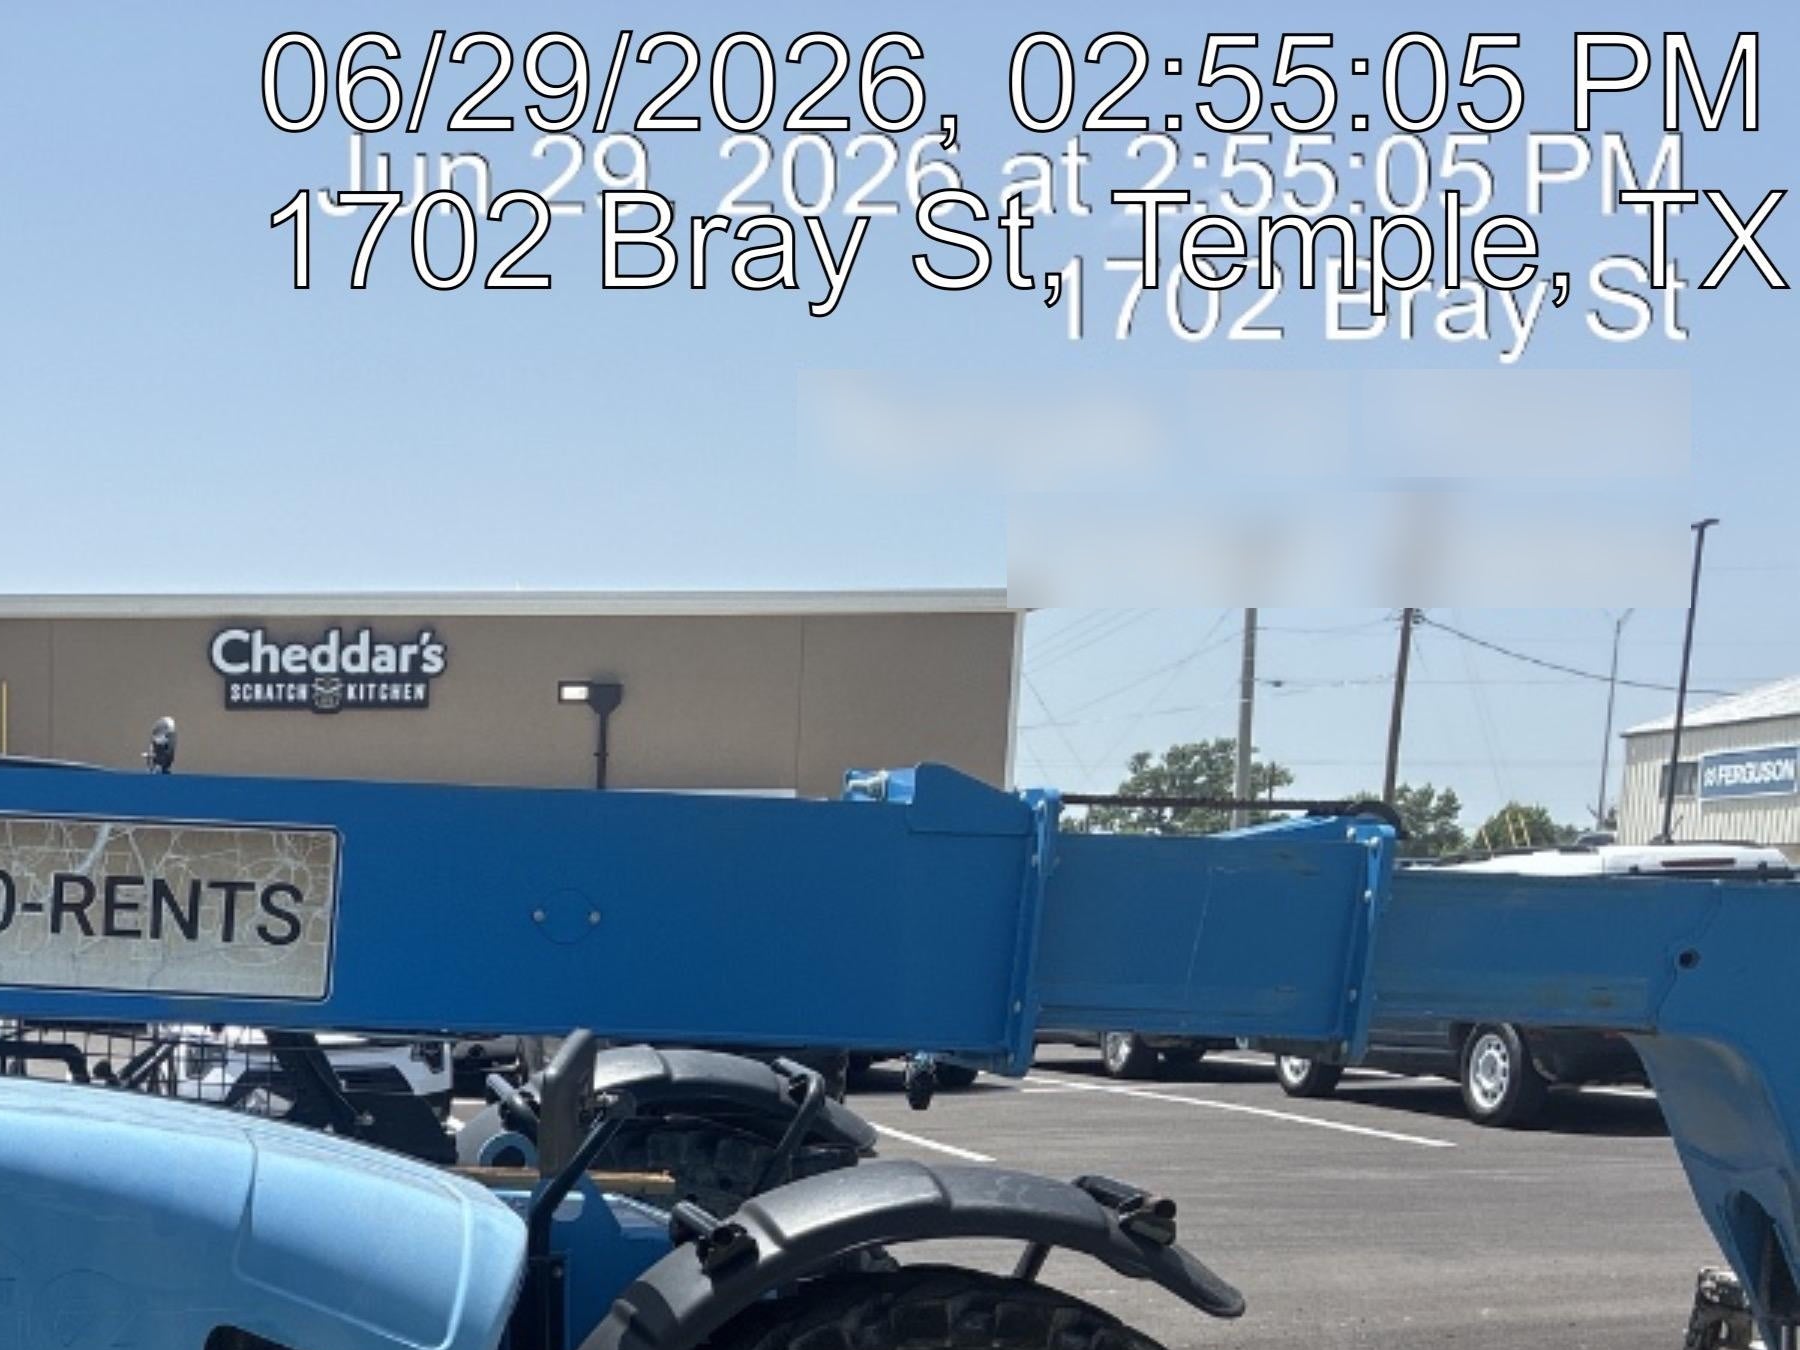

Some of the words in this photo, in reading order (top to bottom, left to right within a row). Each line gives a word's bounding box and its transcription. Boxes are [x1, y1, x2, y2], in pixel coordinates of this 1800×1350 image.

[211, 628, 446, 674] Cheddar's
[230, 683, 308, 702] SCRATCH
[346, 682, 427, 701] KITCHEN
[1717, 758, 1795, 787] FERGUSON
